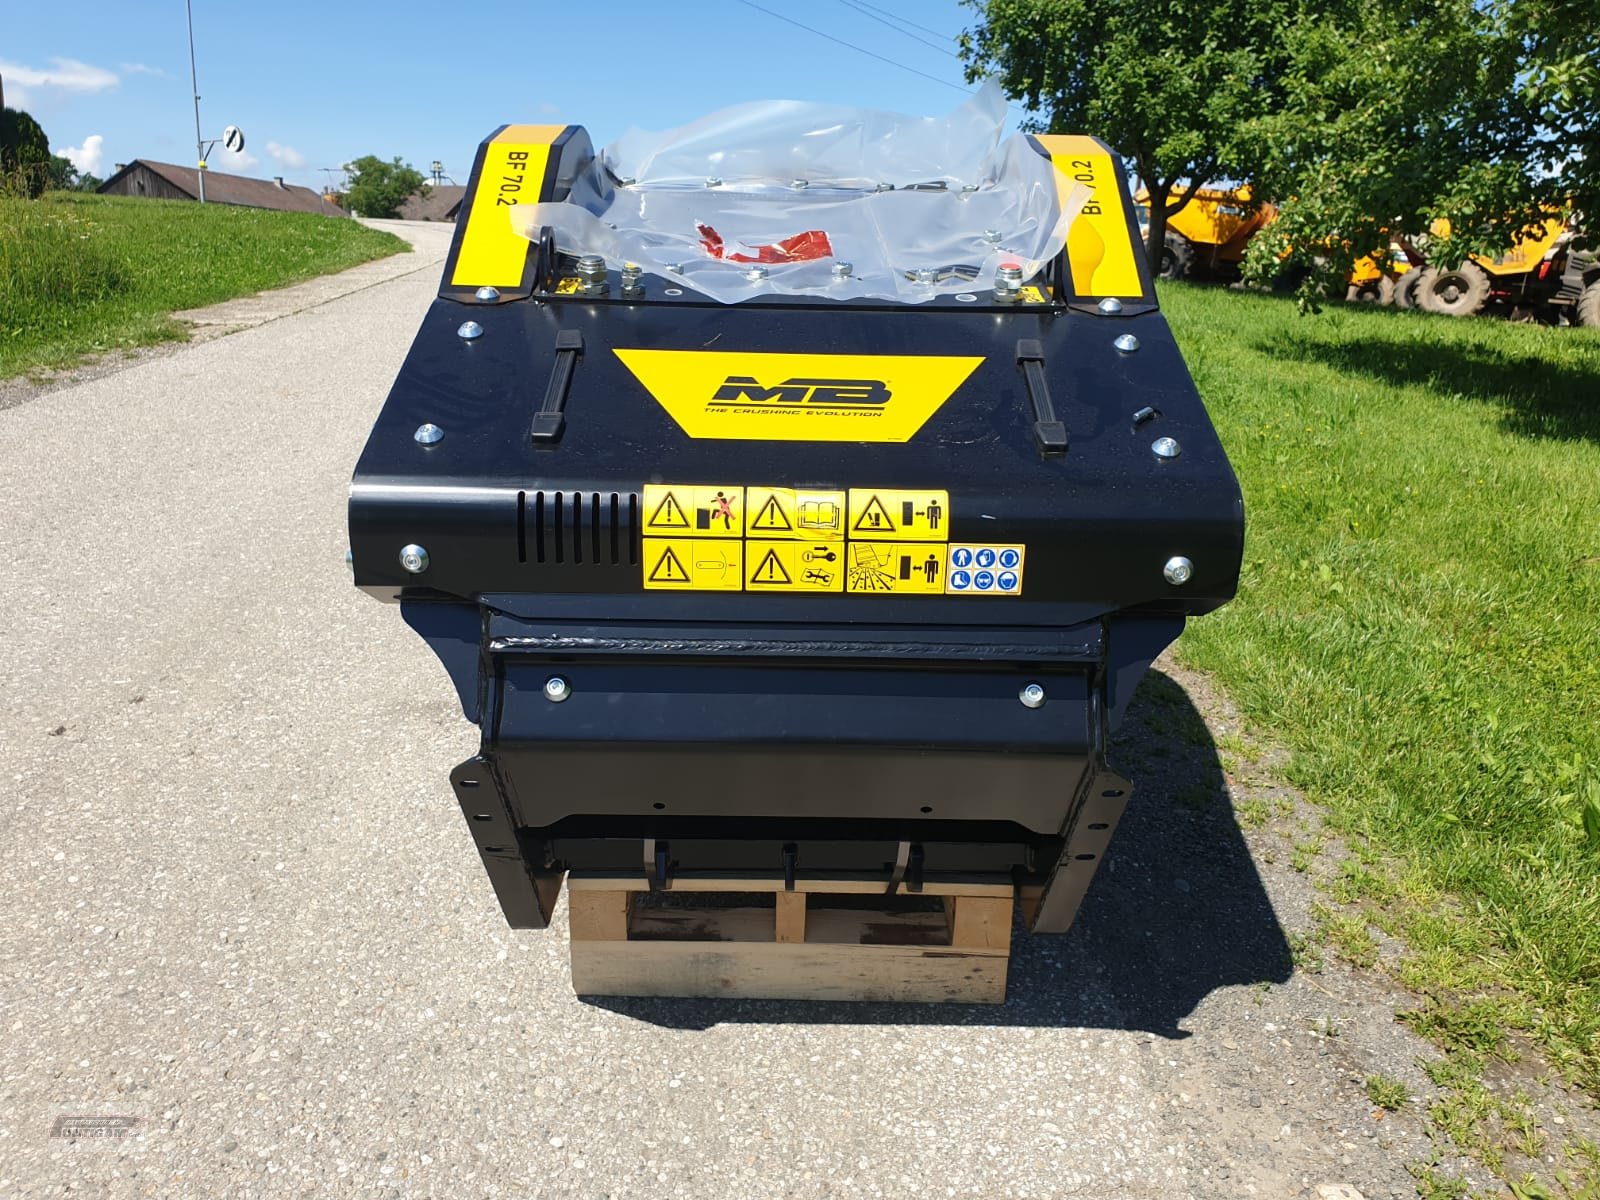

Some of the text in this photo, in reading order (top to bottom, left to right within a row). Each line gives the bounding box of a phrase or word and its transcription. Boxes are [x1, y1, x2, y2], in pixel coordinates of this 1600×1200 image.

[496, 151, 529, 206] BF 70.2
[711, 376, 893, 405] MB
